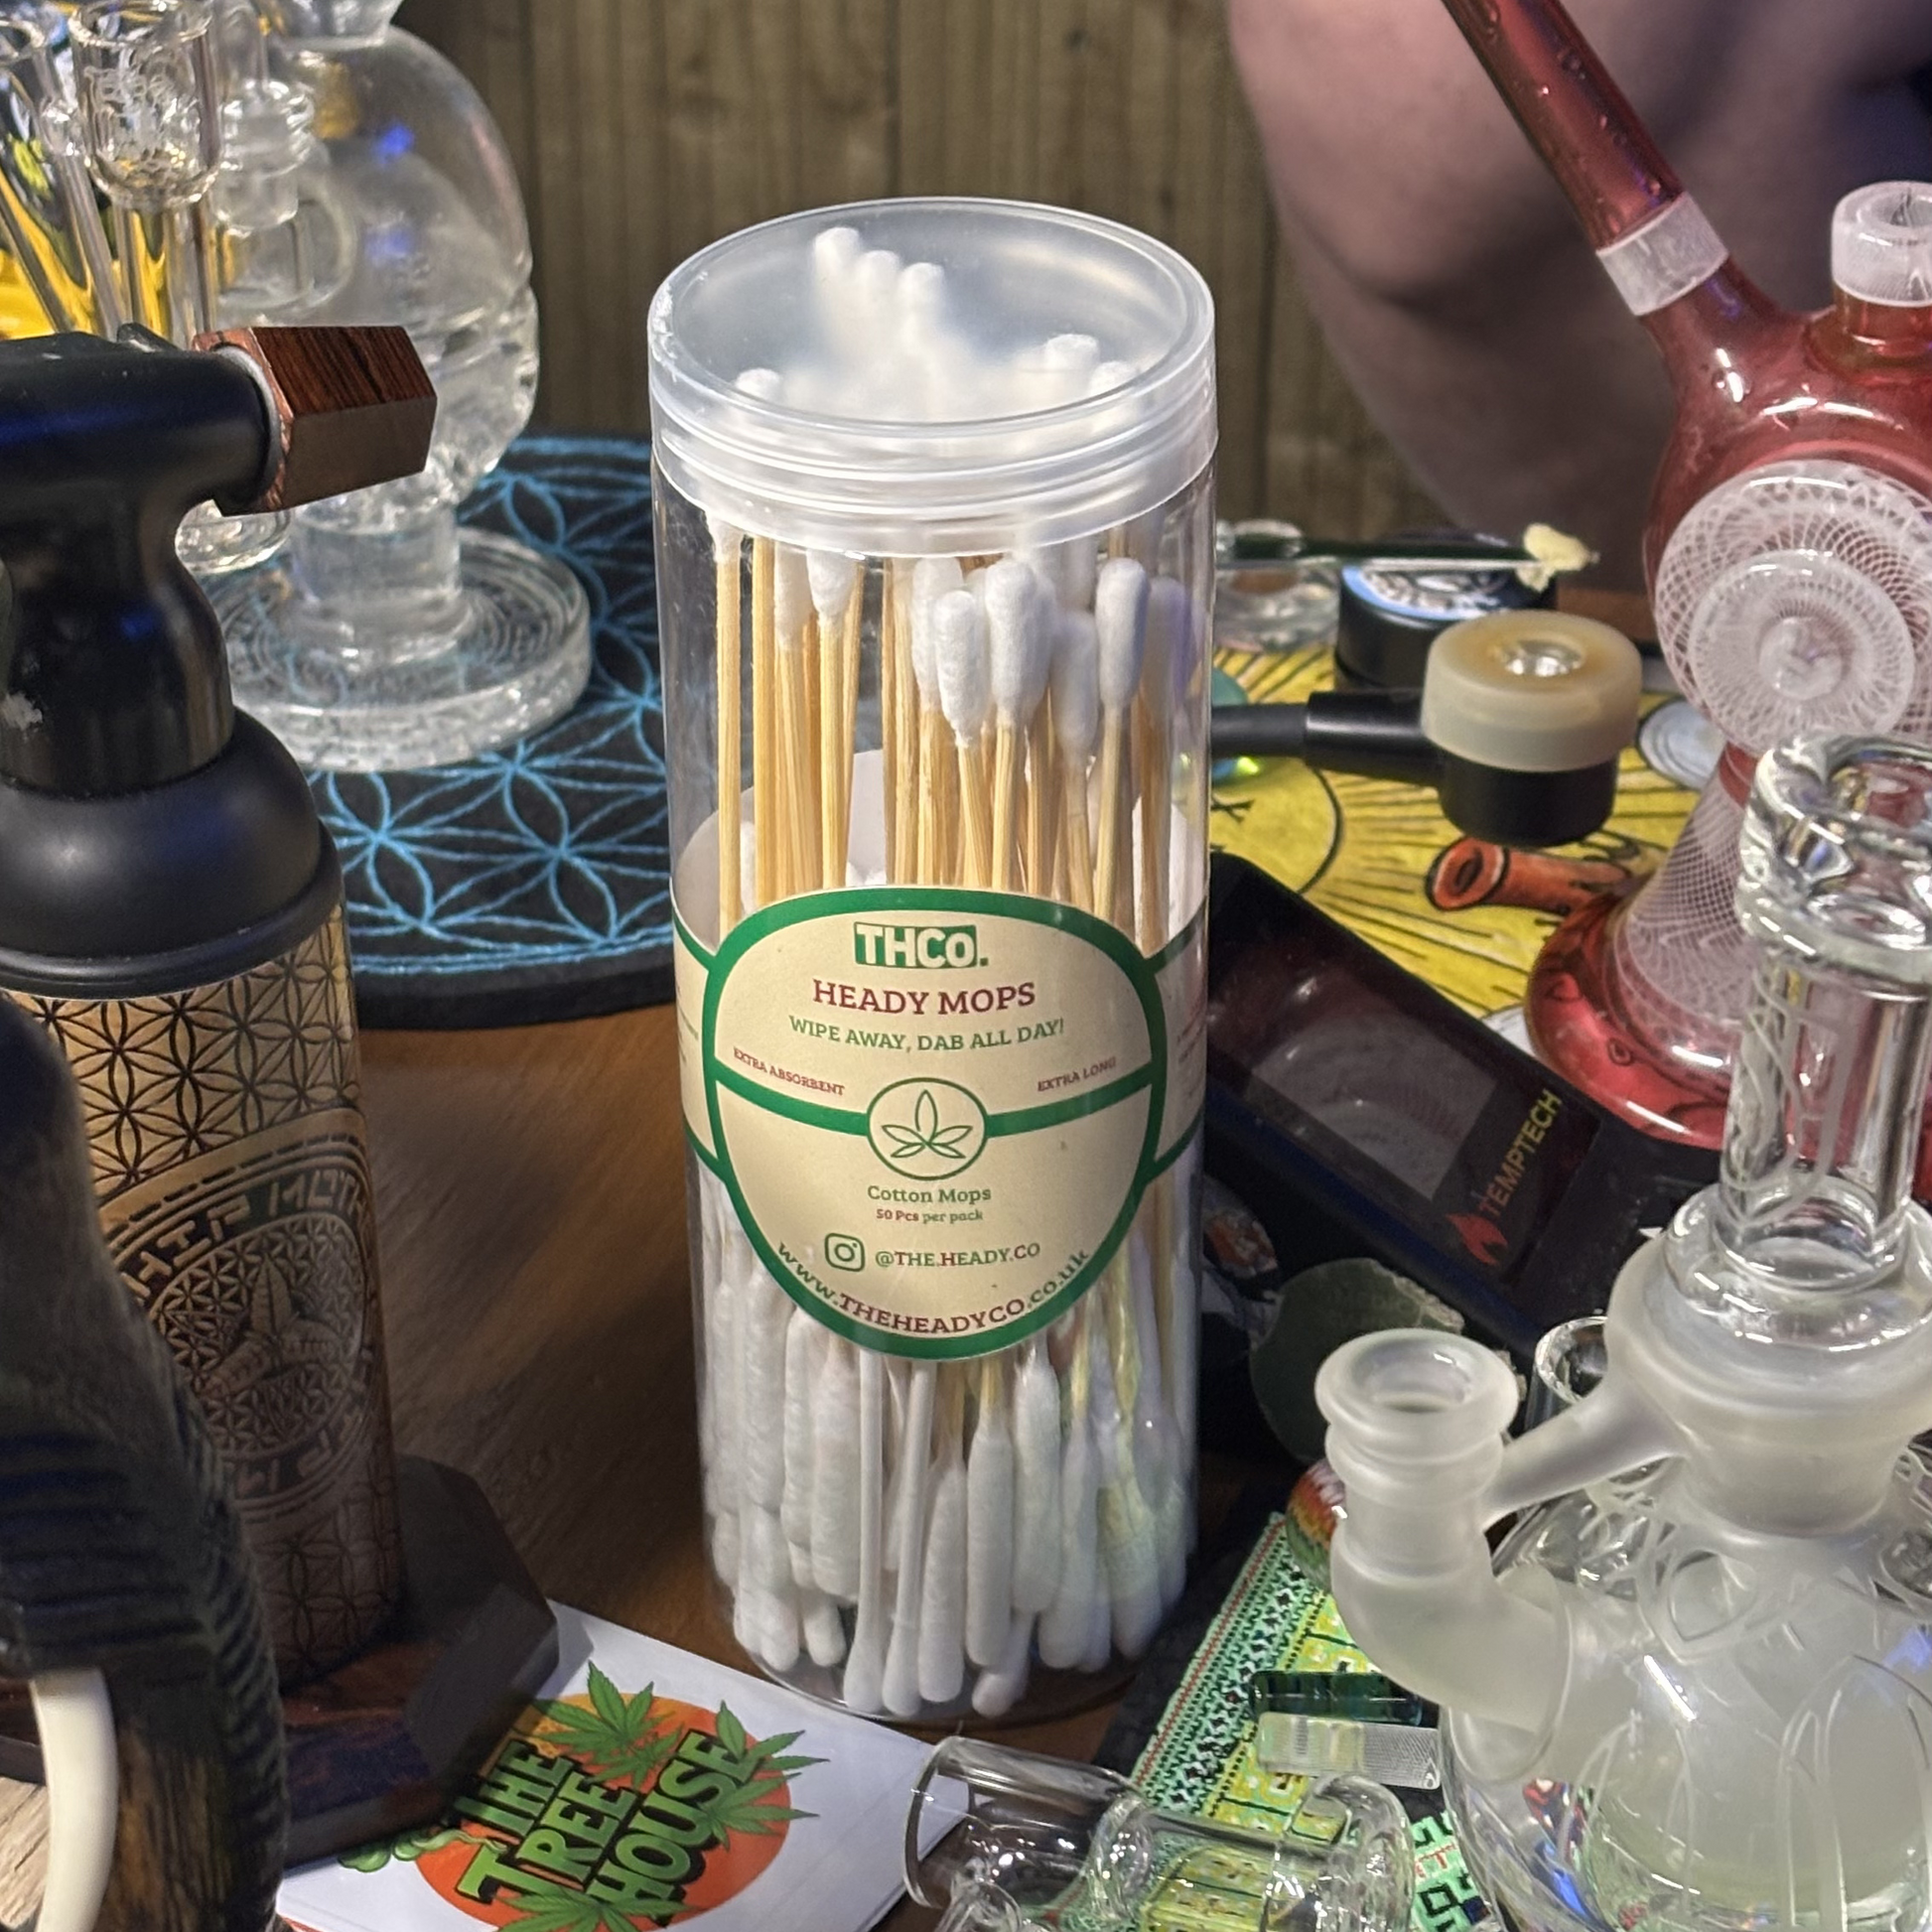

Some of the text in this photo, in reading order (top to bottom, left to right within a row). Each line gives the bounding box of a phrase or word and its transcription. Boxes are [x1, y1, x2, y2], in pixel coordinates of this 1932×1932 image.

[812, 978, 1035, 1015] HEADY MOPS
[788, 1015, 1064, 1052] WIPE AWAY, DAB ALL DAY!
[733, 1045, 846, 1096] EXTRA ABSORBENT
[1037, 1055, 1117, 1092] EXTRA LONG
[1478, 1087, 1563, 1217] TEMPTECH
[867, 1184, 992, 1205] Cotton Mops
[876, 1208, 984, 1224] 50 Pcs per pack
[875, 1242, 1041, 1268] @THE.HEADY.CO
[456, 1770, 642, 1901] TREE
[584, 1728, 764, 1922] HOUSE
